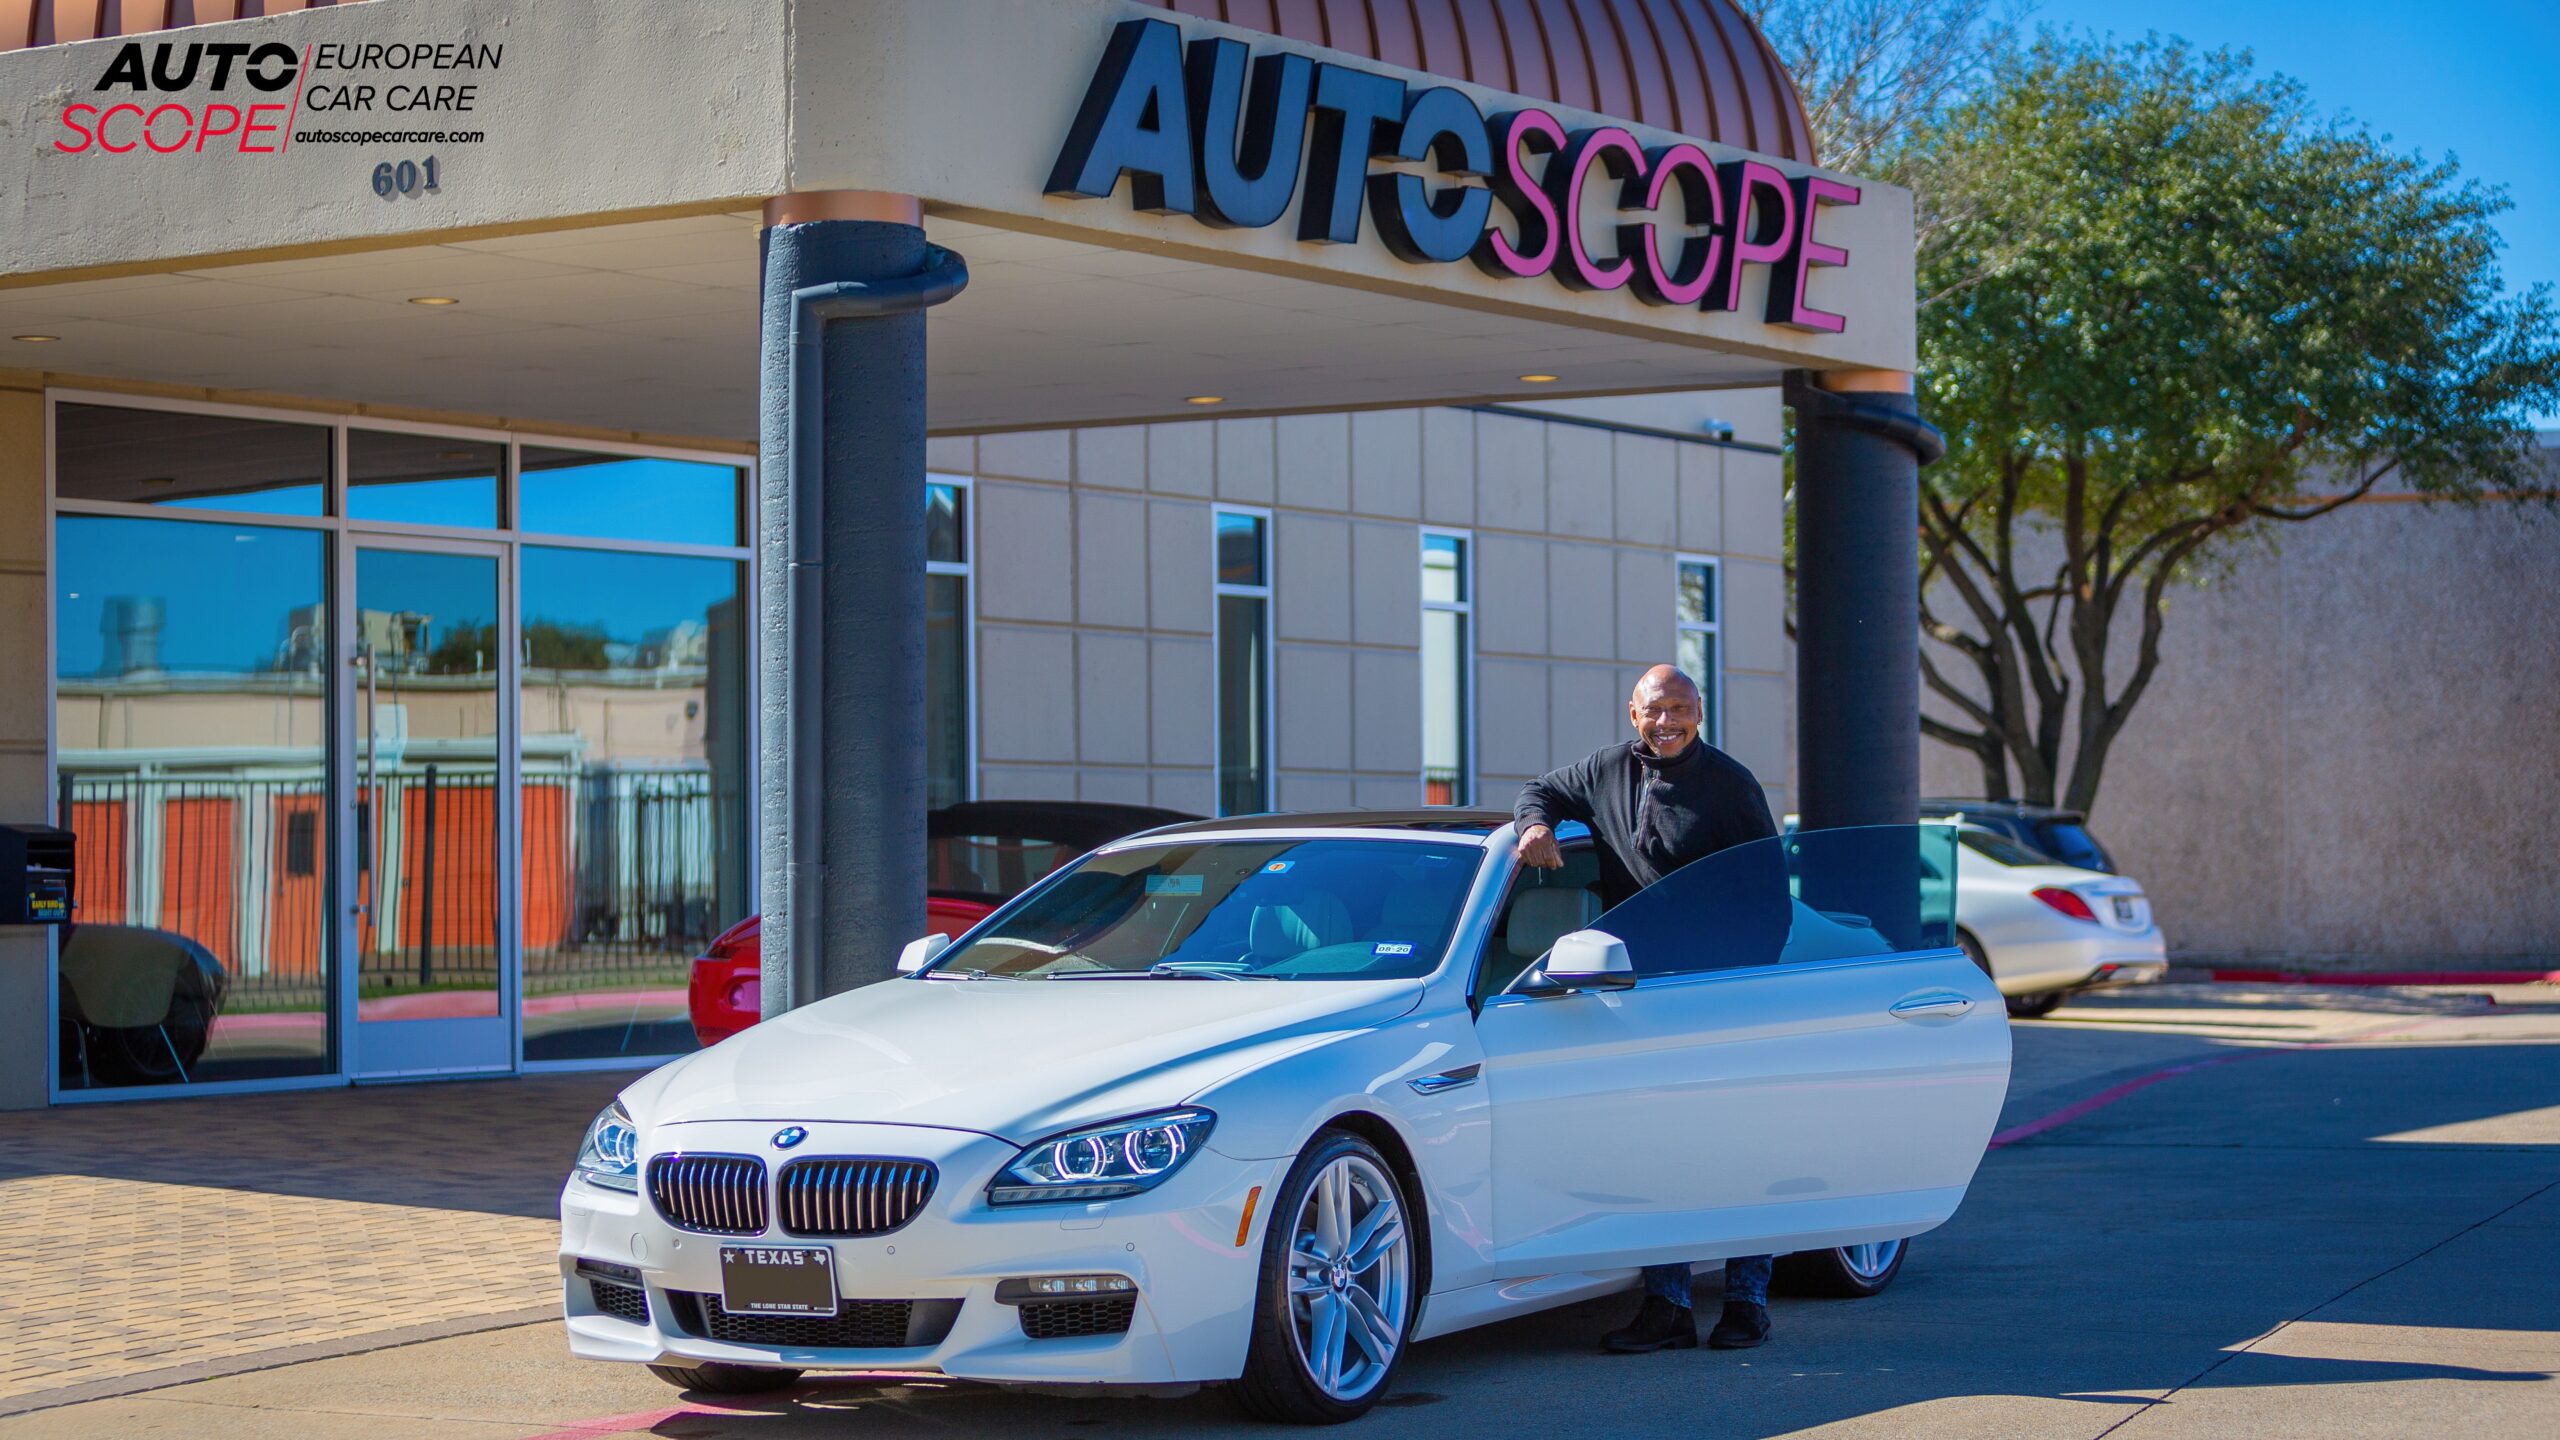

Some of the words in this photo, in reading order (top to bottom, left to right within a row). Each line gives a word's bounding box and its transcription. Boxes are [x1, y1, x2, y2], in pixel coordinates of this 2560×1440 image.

[372, 155, 439, 196] 601
[1043, 18, 1862, 333] AUTOSCOPE
[744, 1250, 804, 1265] TEXAS
